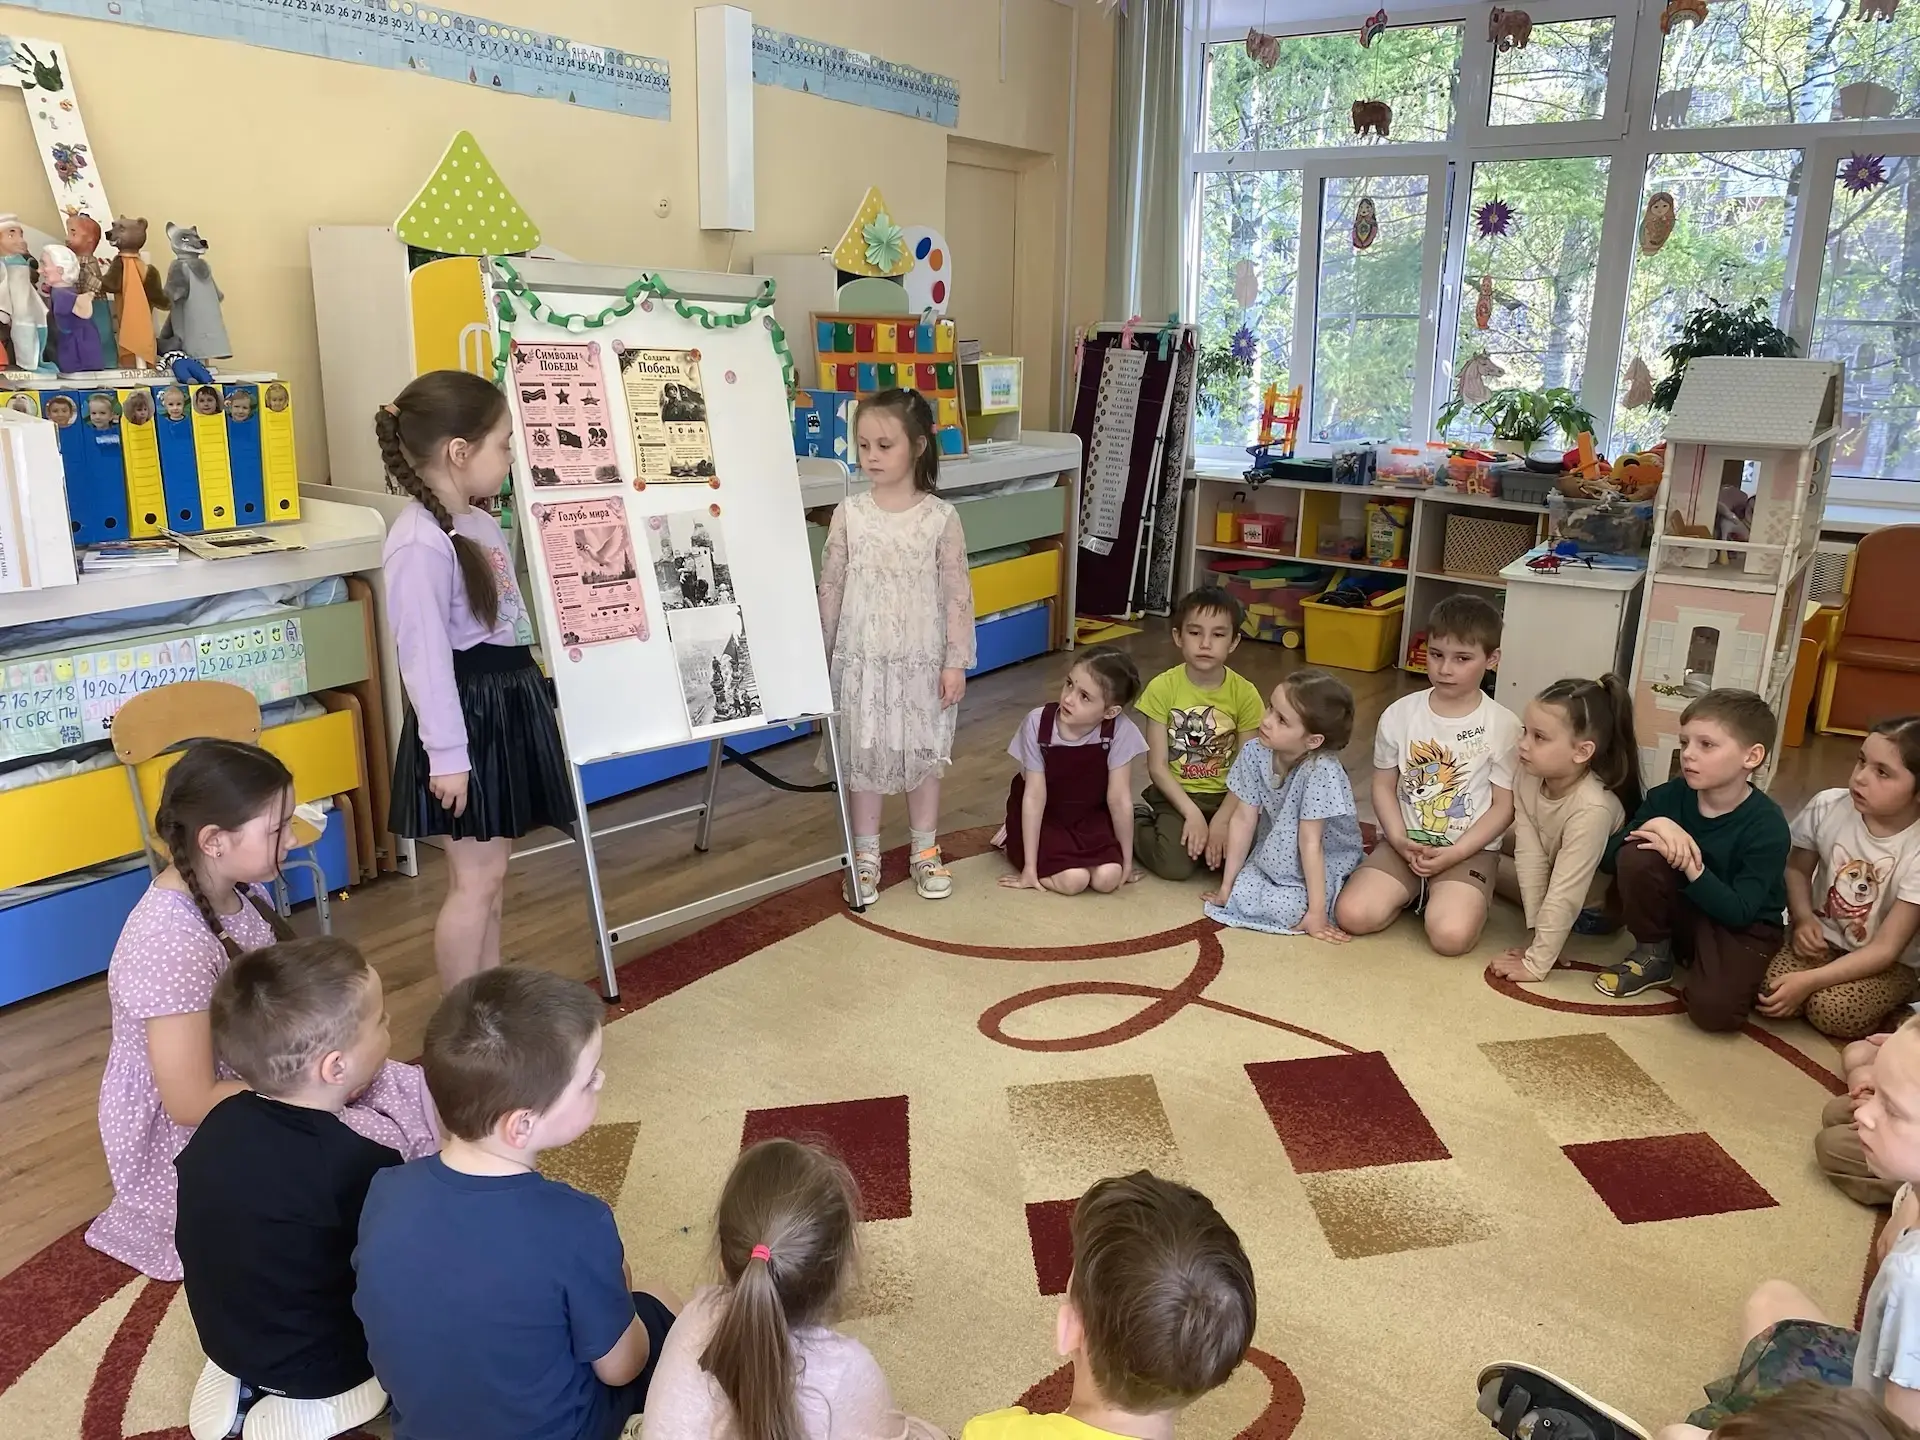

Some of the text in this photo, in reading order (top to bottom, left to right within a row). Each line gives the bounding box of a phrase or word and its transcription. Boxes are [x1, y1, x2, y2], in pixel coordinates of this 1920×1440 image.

[296, 0, 307, 10] 23
[310, 2, 321, 12] 24
[324, 4, 335, 15] 25
[338, 7, 349, 18] 26
[351, 9, 362, 20] 27
[365, 12, 376, 23] 28
[378, 15, 389, 26] 29
[391, 18, 402, 29] 30
[403, 21, 414, 32] 31
[643, 353, 671, 362] Солдаты
[638, 361, 681, 375] Победы
[558, 509, 610, 523] Голубь мира
[200, 643, 304, 675] 25 26 27 28 29 30
[82, 679, 96, 700] 19
[99, 679, 117, 697] 20
[119, 670, 138, 693] 21
[141, 669, 158, 689] 22
[159, 668, 176, 688] 23
[12, 692, 29, 710] 16
[33, 689, 53, 704] 17
[56, 685, 75, 701] 18
[37, 710, 54, 726] ВС
[59, 706, 78, 720] ПН
[1456, 725, 1486, 741] BREAK
[1459, 743, 1491, 761] RULES
